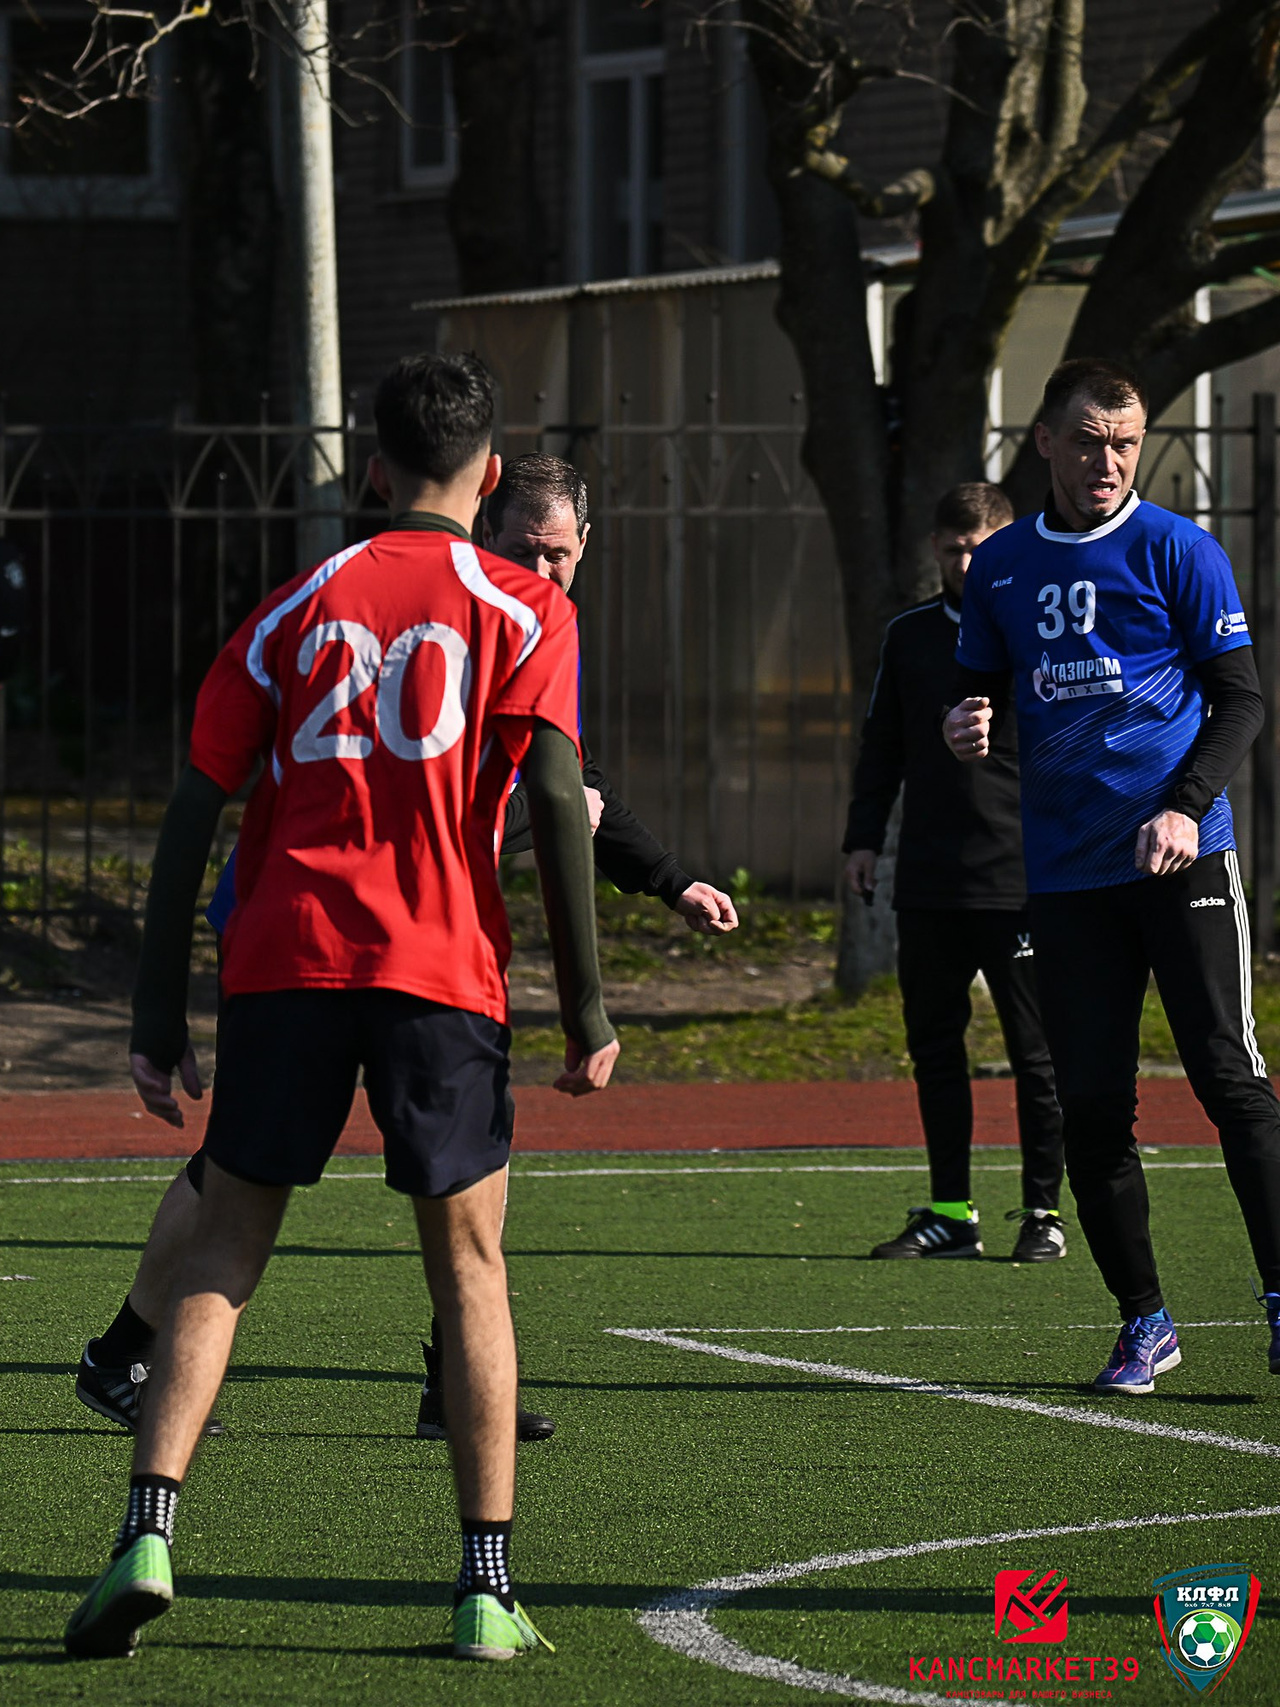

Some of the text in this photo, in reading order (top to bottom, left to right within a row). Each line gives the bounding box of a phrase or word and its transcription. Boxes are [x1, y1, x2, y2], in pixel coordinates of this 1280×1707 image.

[1036, 580, 1097, 640] 39
[1051, 657, 1122, 683] ГАЗПРОМ
[290, 619, 472, 764] 20
[1067, 682, 1108, 697] ПХГ
[1190, 896, 1227, 908] adidas
